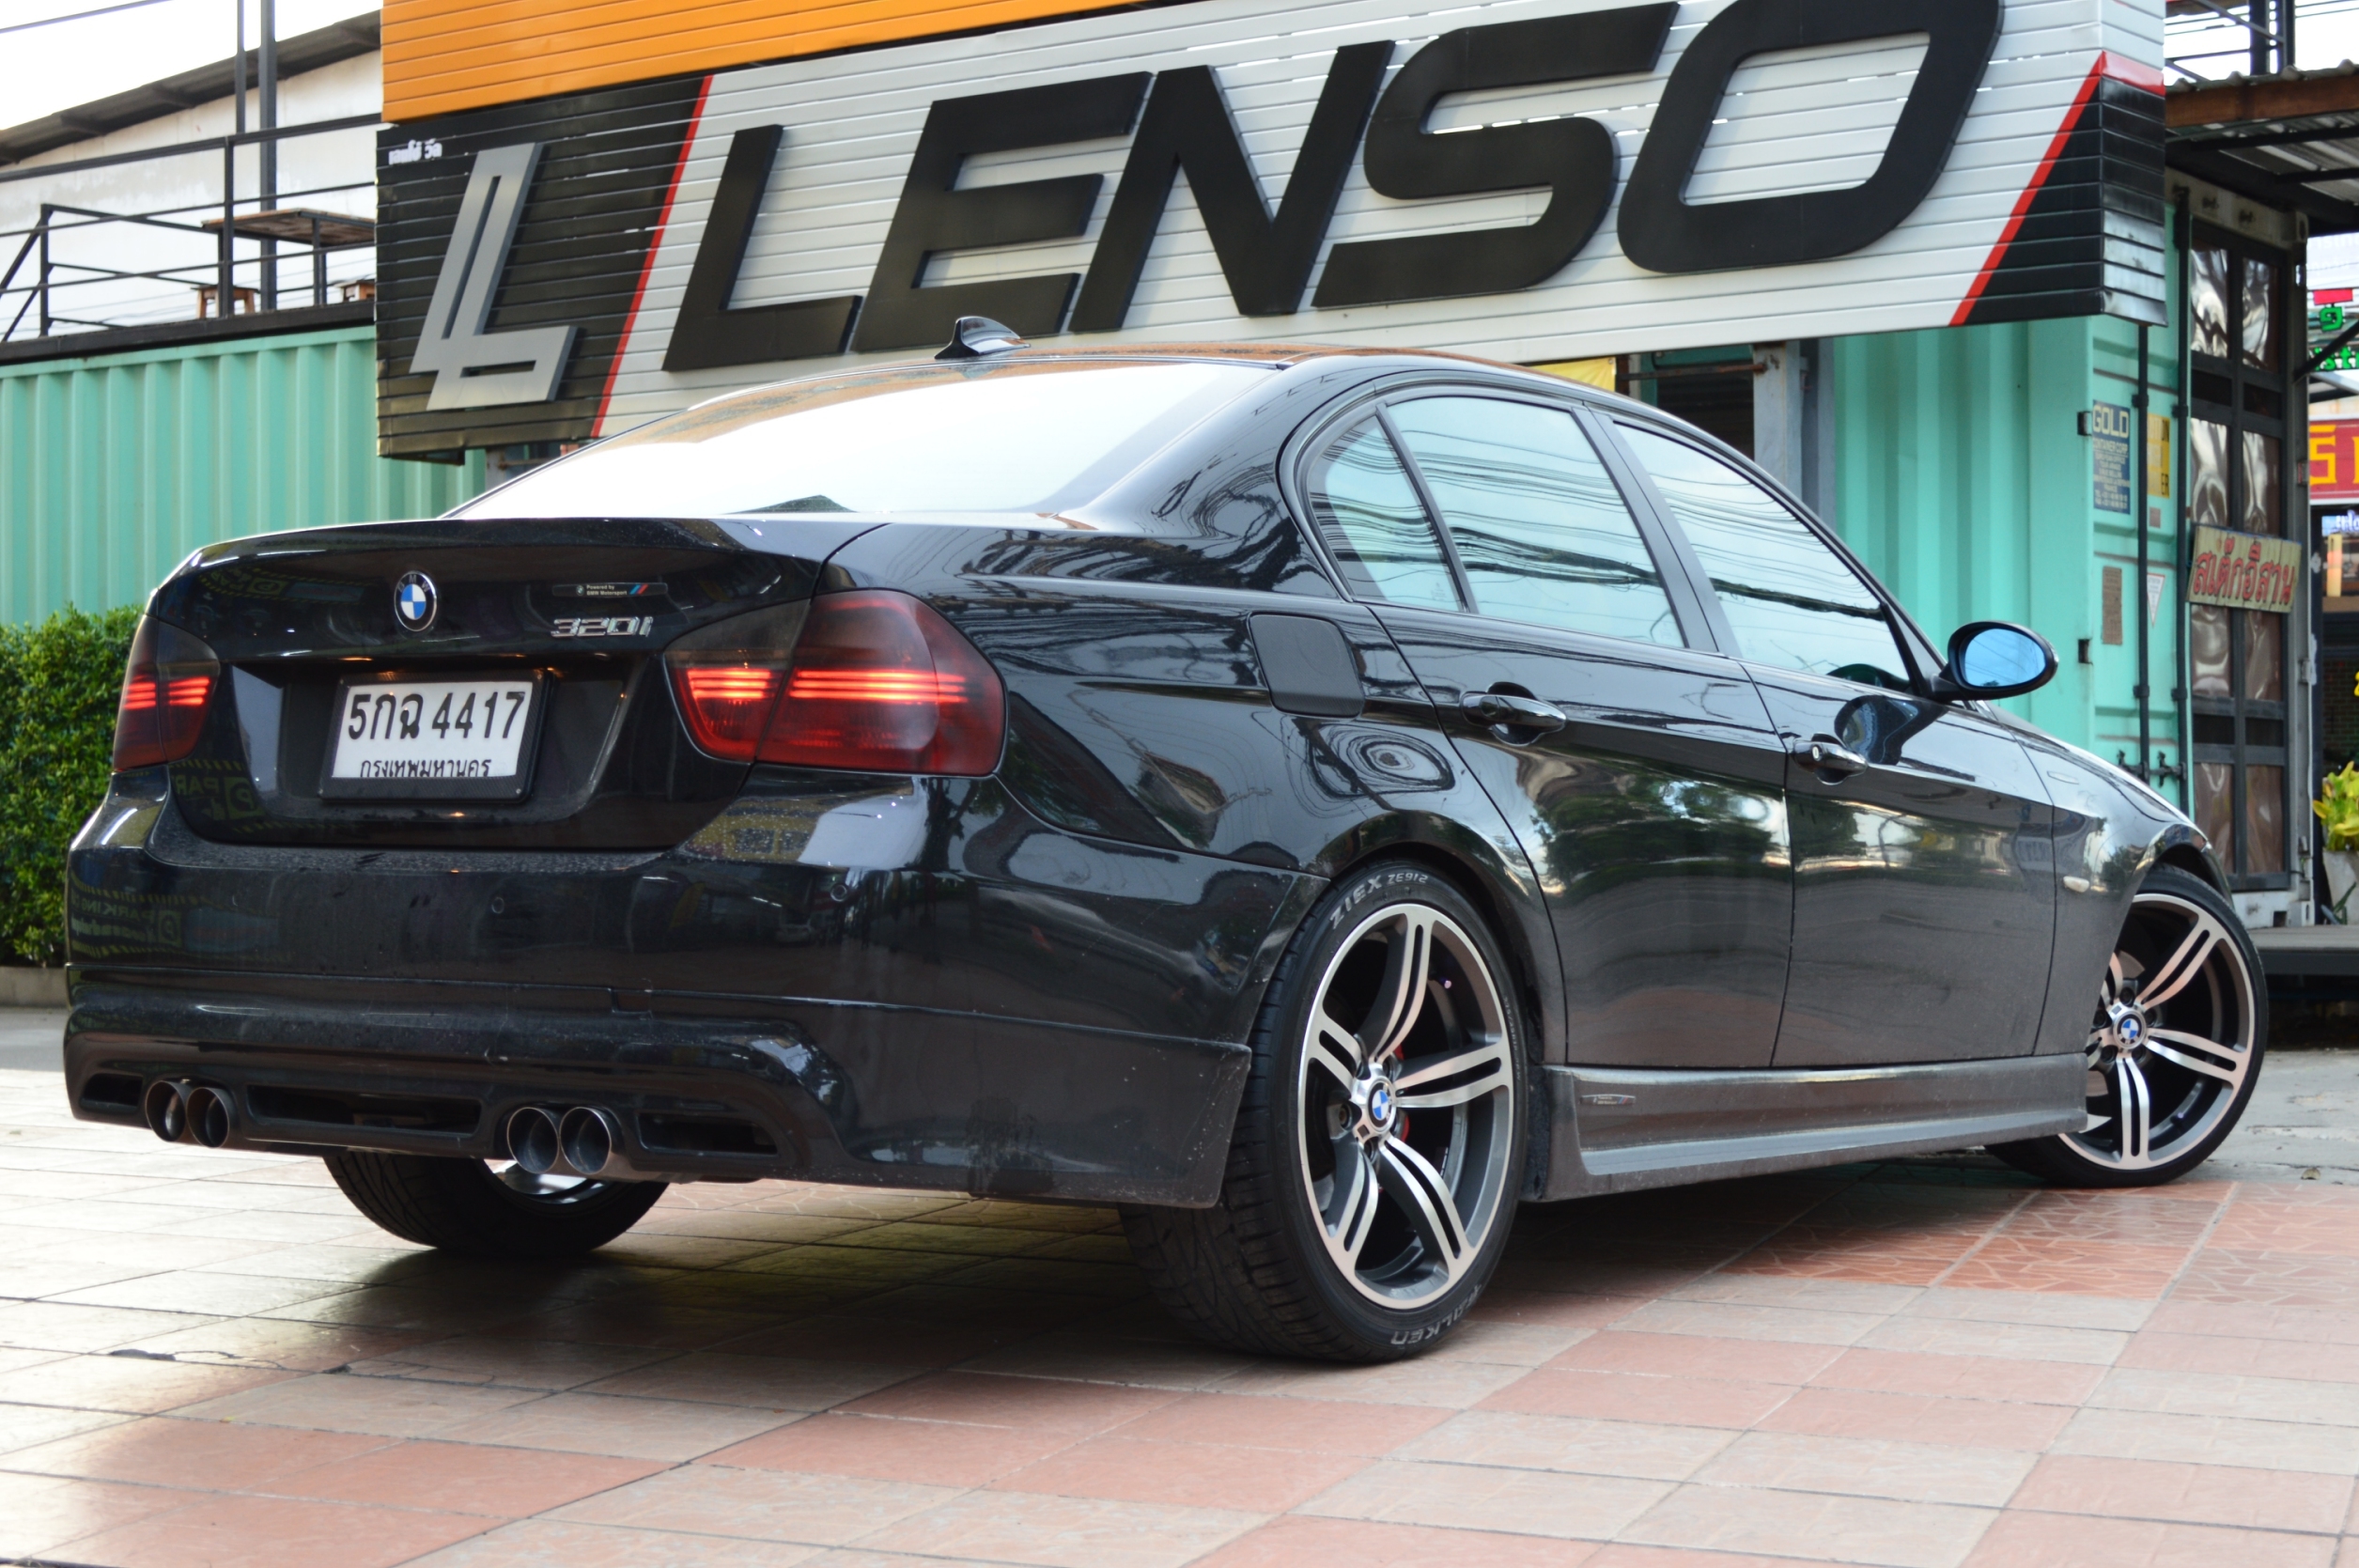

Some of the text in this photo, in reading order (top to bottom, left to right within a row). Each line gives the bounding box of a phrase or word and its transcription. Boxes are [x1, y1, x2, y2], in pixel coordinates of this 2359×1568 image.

[663, 0, 2004, 371] LENSO
[2092, 404, 2130, 439] GOLD
[551, 616, 654, 637] 320i
[432, 691, 525, 739] 4417
[360, 759, 491, 778] กรงเทพมหานคร
[1329, 872, 1429, 930] ZIEX ZE912
